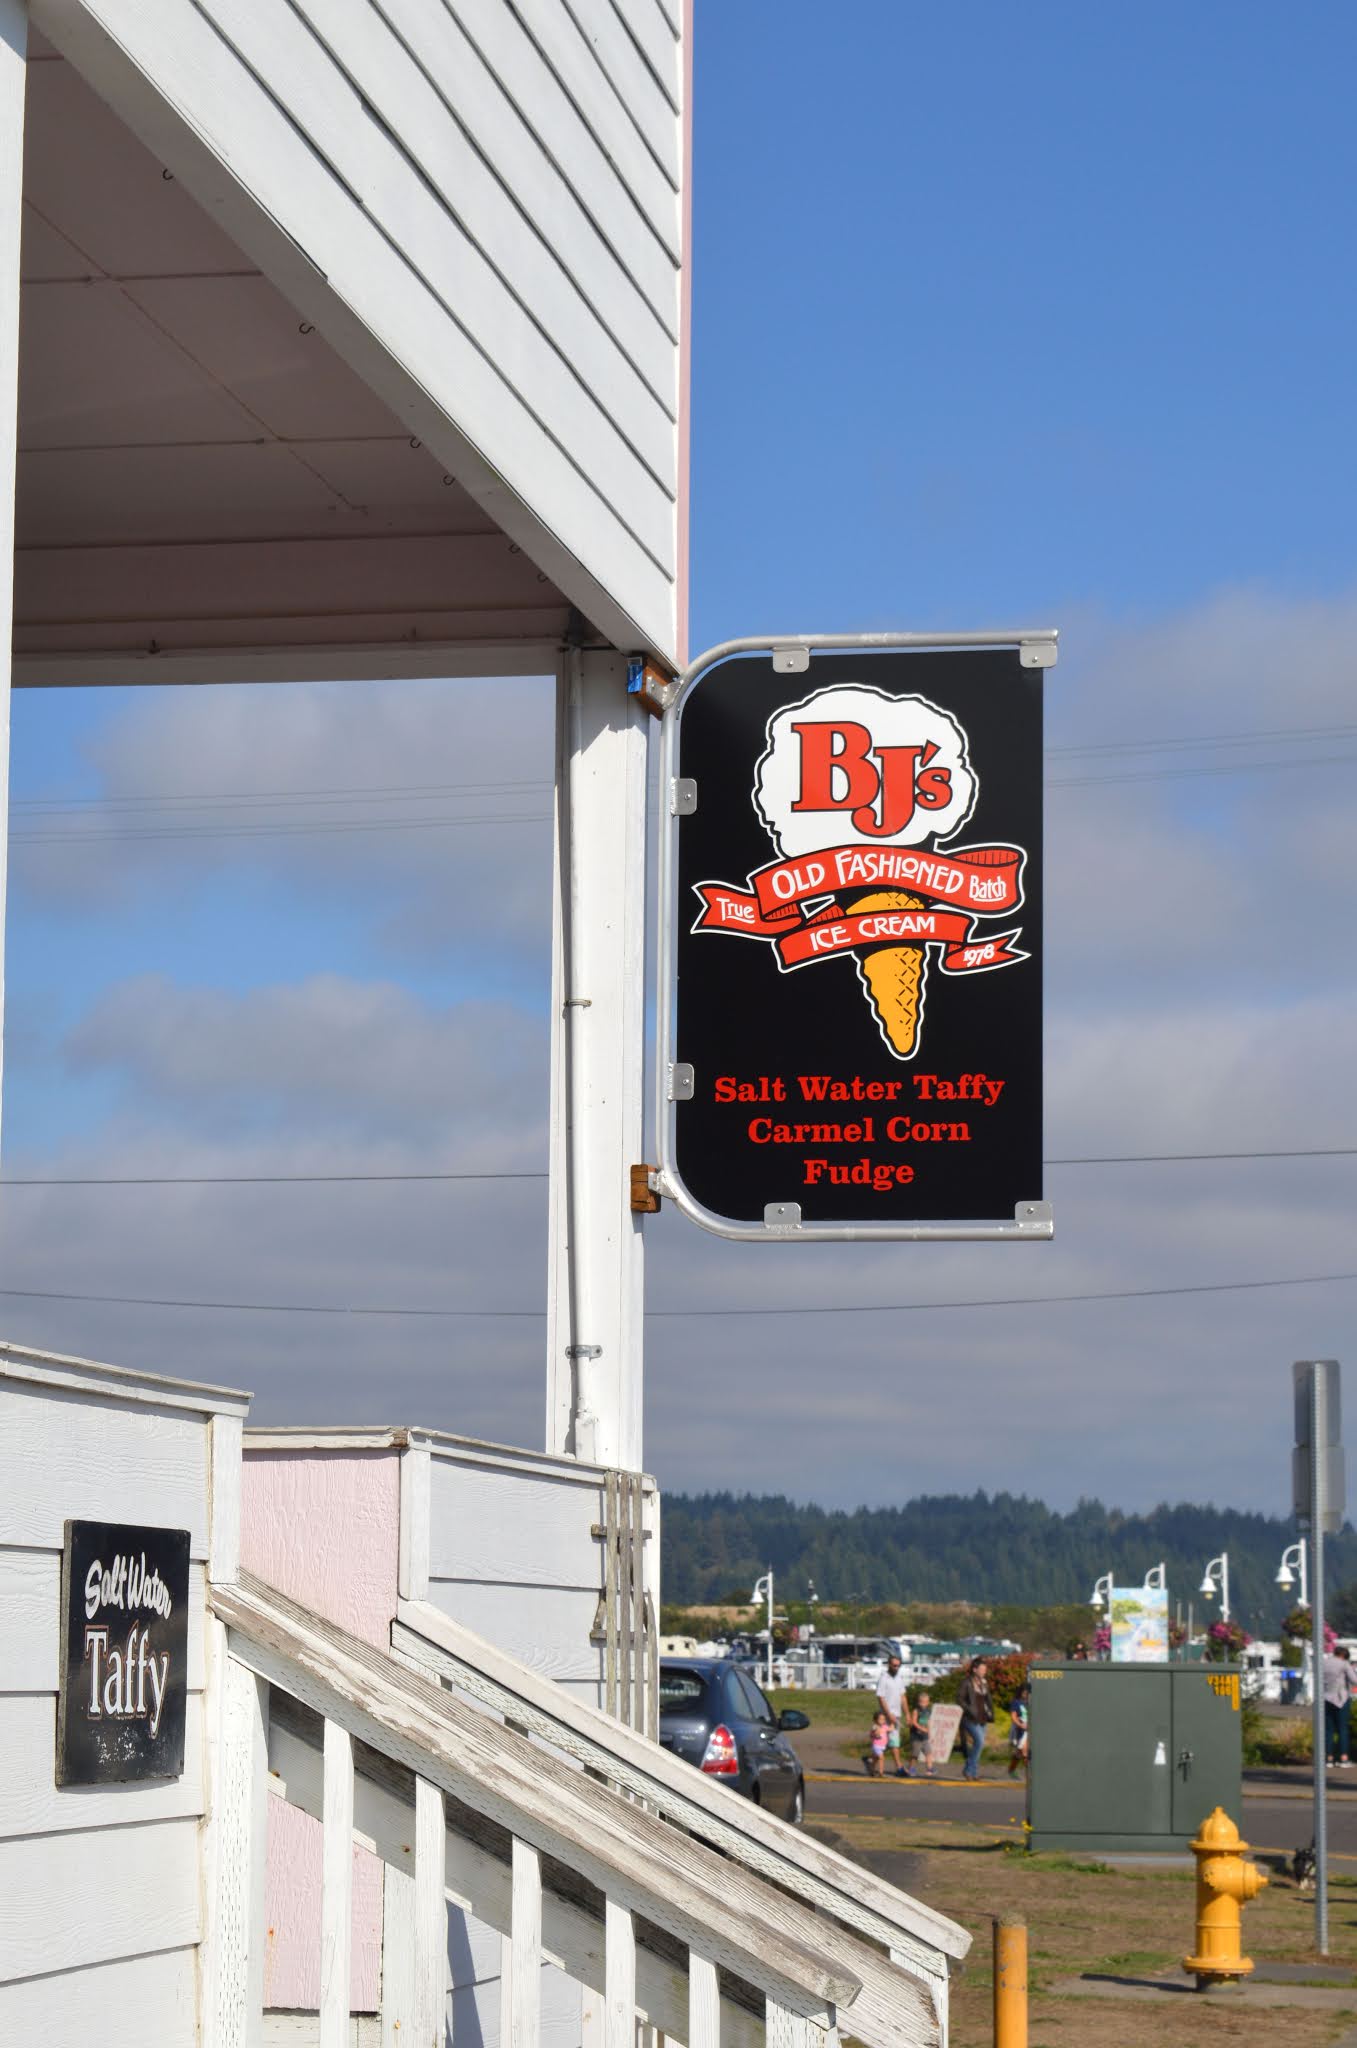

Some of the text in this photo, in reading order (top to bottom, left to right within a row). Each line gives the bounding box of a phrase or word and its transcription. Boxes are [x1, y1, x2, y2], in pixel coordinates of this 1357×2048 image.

[791, 720, 953, 839] BJ's
[772, 849, 964, 899] OLD FASHIONED
[969, 875, 1007, 902] Batch
[716, 897, 755, 924] True
[809, 915, 936, 951] ICE CREAM
[963, 944, 995, 967] 1978
[714, 1073, 1006, 1106] Salt Water Taffy
[748, 1116, 971, 1143] Carmel Corn
[803, 1159, 914, 1191] Fudge
[84, 1552, 173, 1620] Salt Water
[84, 1621, 170, 1739] Taffy
